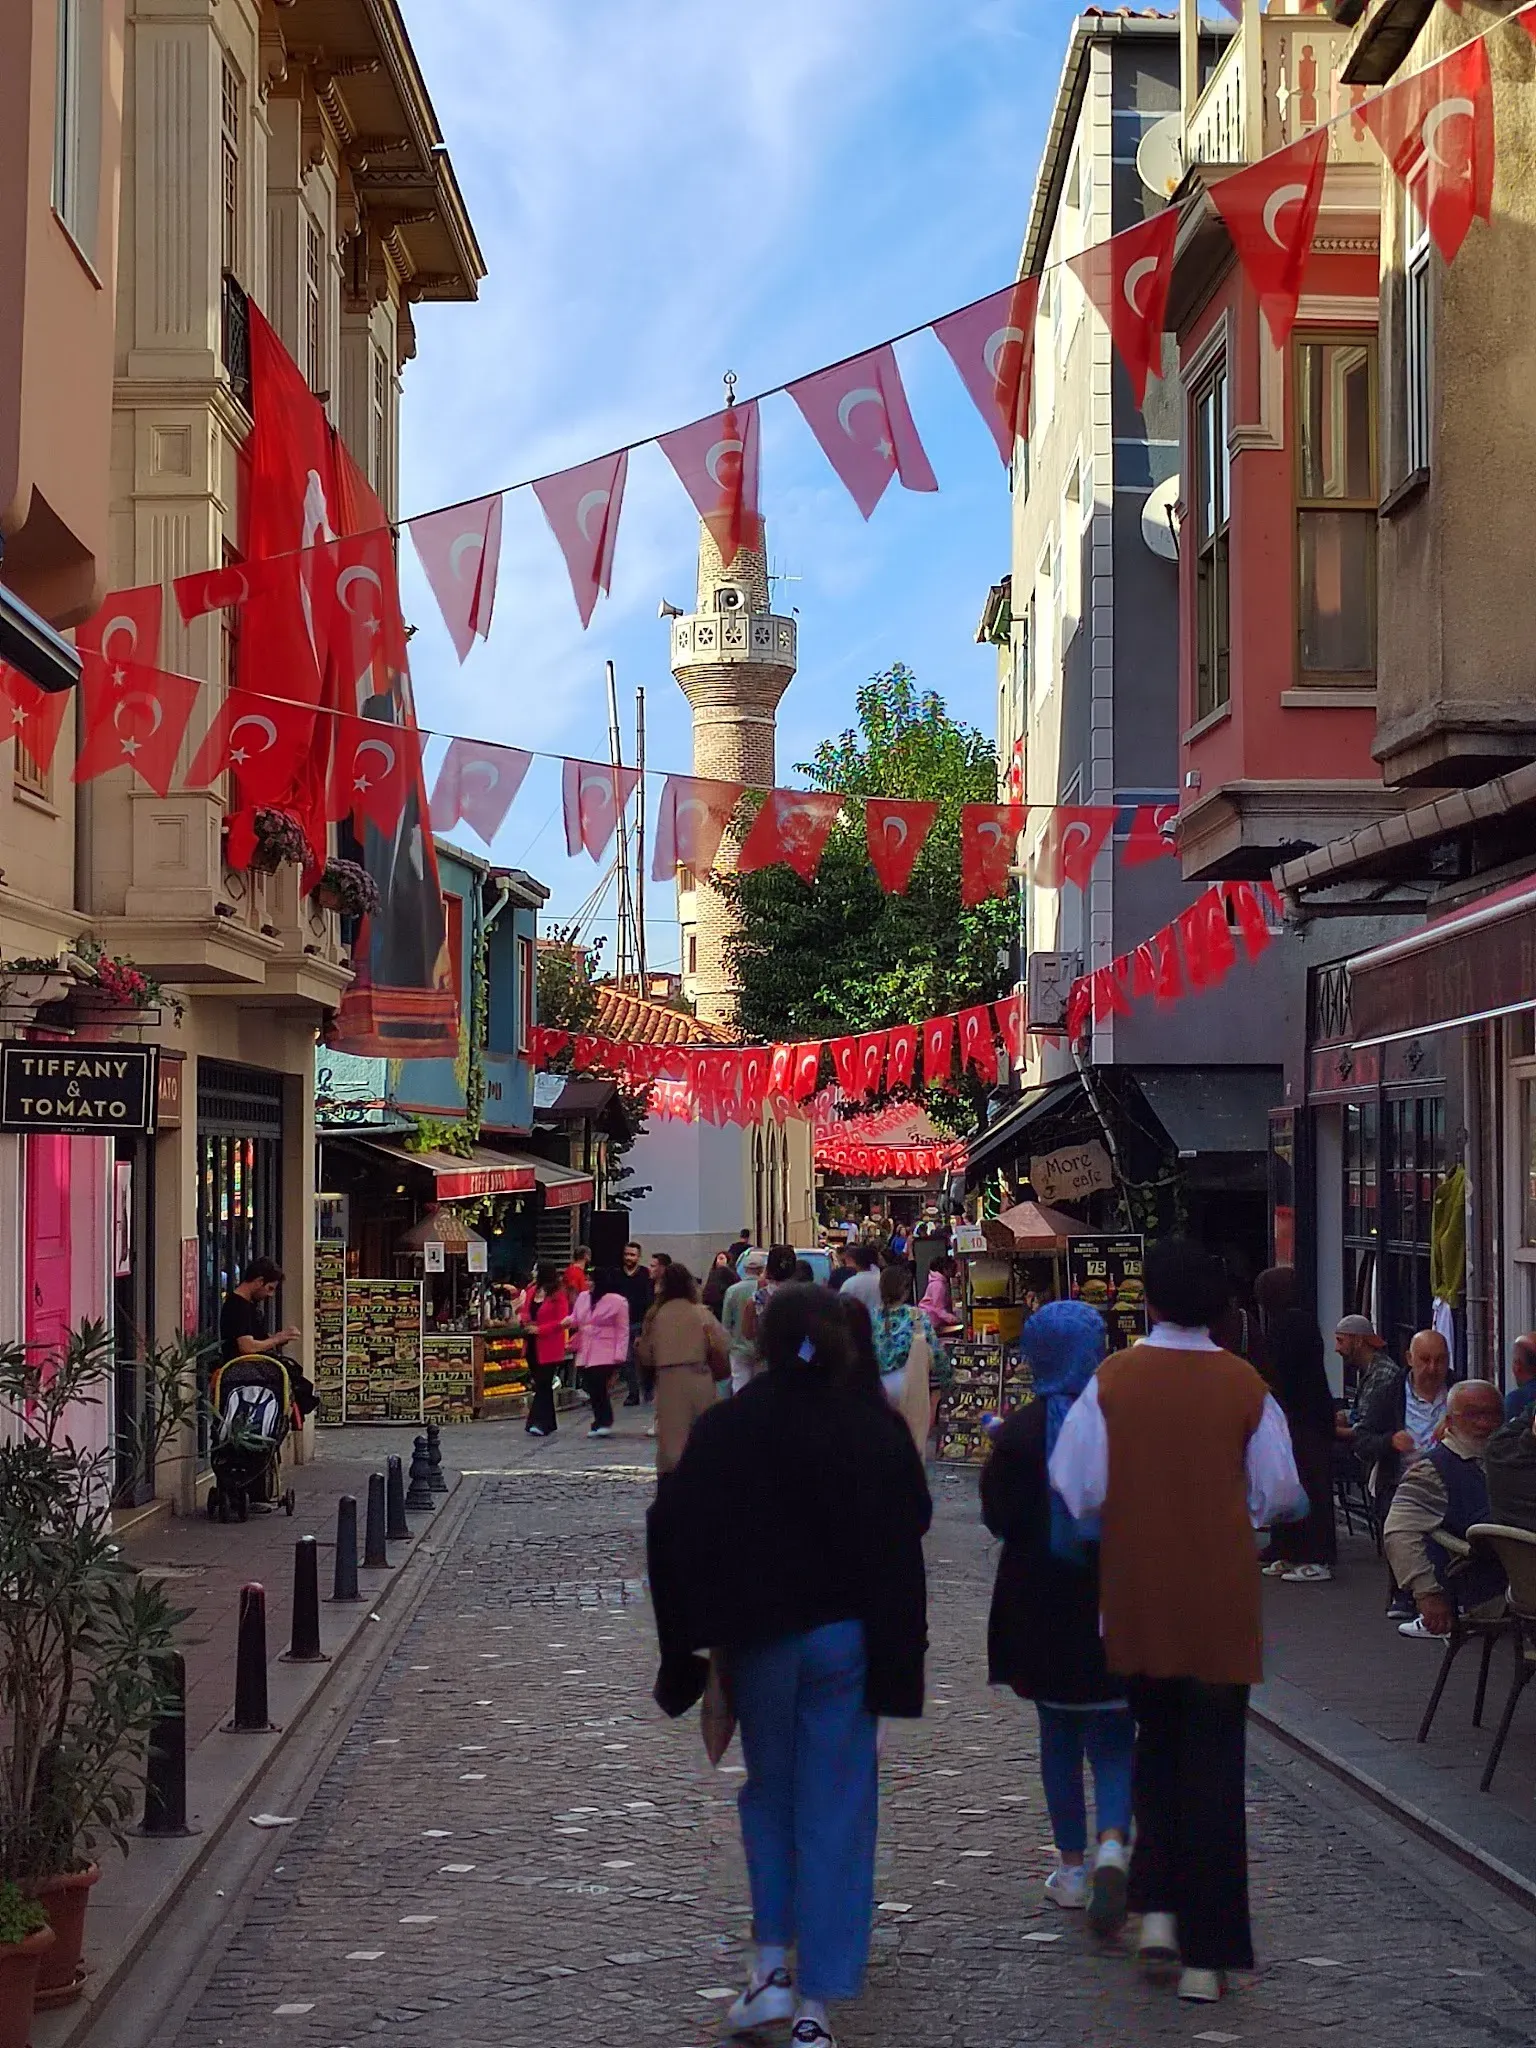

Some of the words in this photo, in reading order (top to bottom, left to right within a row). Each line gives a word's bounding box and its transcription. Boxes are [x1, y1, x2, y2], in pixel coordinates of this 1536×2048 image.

[22, 1059, 128, 1078] TIFFANY
[66, 1080, 81, 1098] &
[21, 1098, 127, 1118] TOMATO
[1046, 1154, 1092, 1178] More
[1072, 1170, 1102, 1189] cafe
[972, 1237, 982, 1248] 10
[1090, 1262, 1105, 1274] 75
[1125, 1262, 1140, 1274] 75
